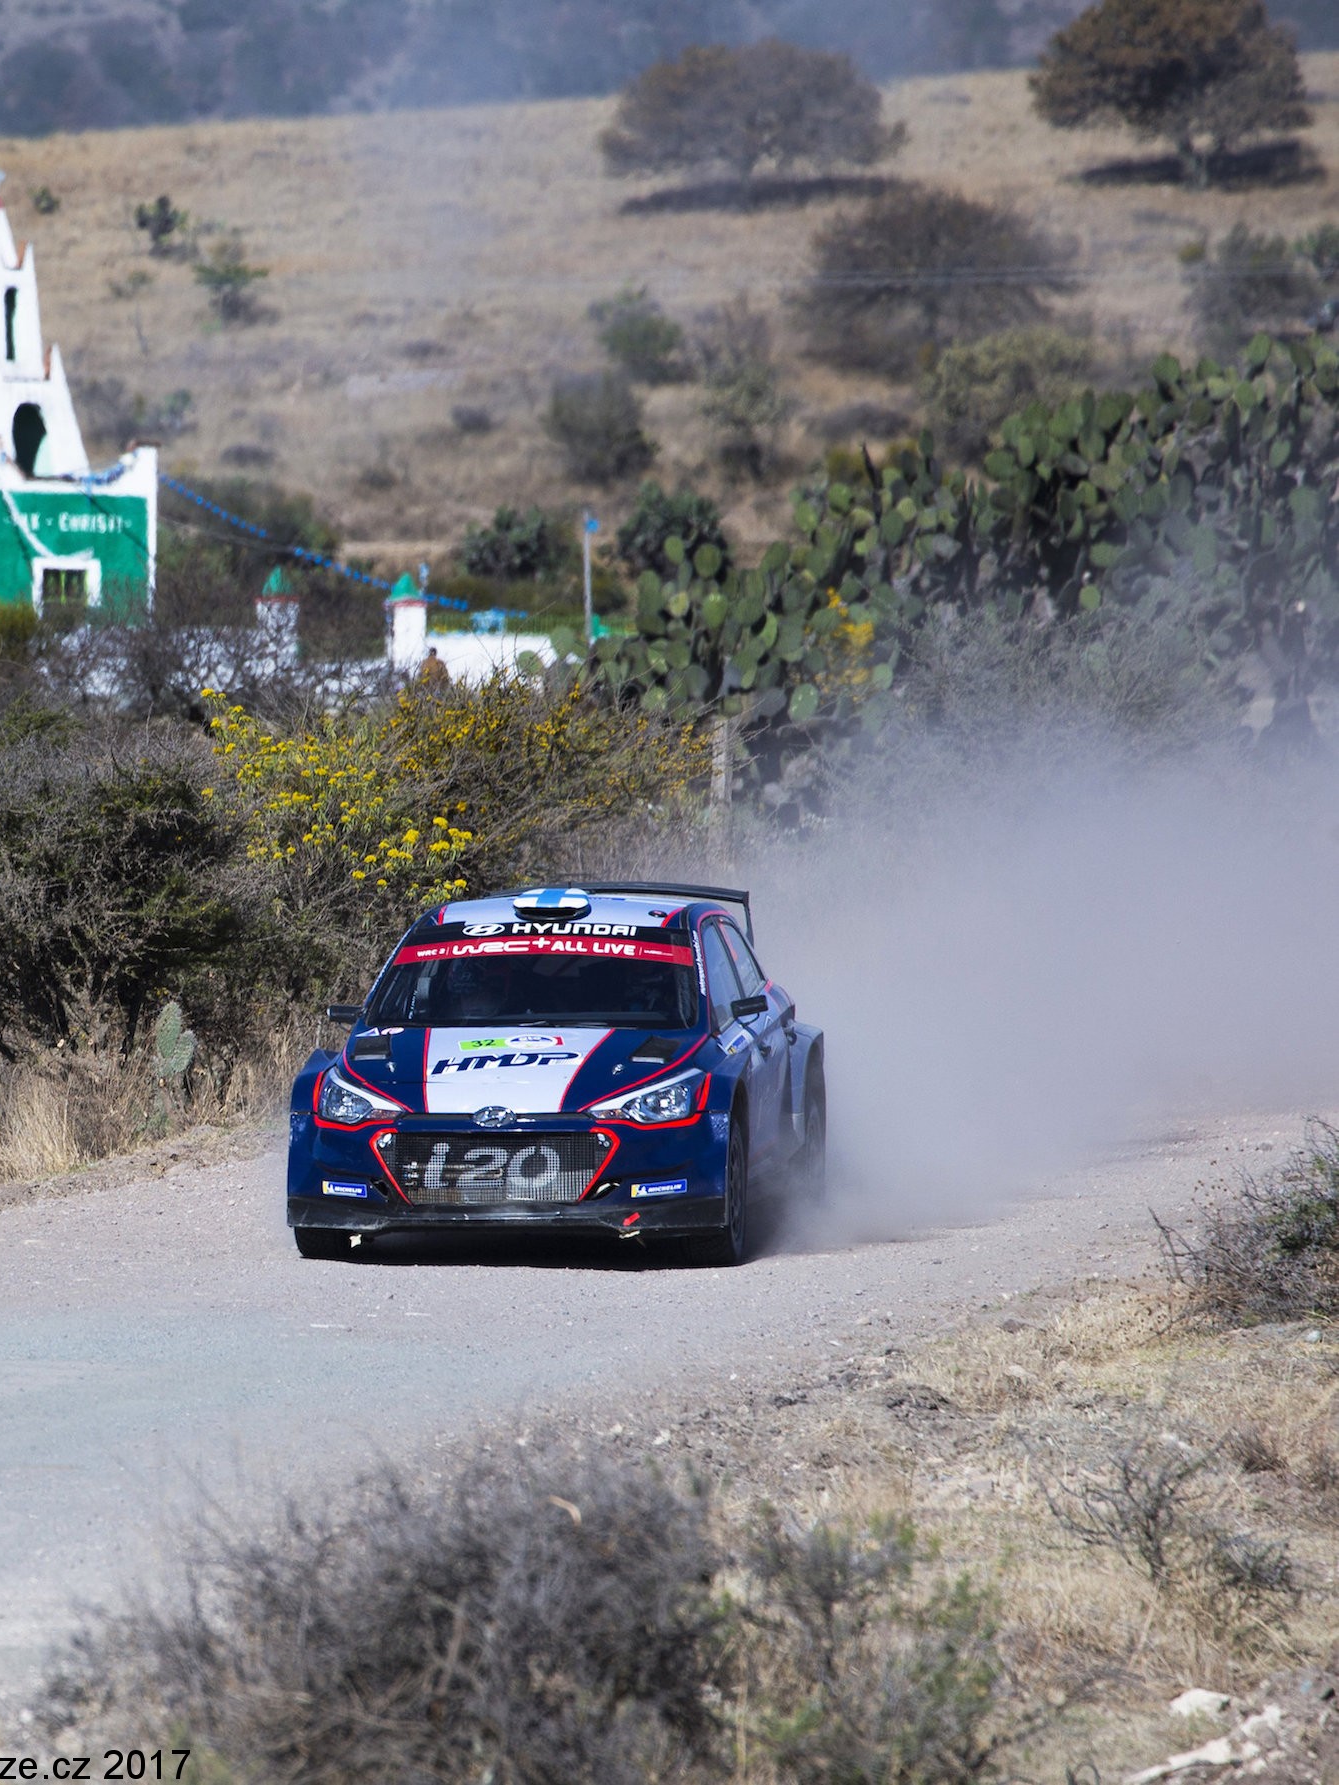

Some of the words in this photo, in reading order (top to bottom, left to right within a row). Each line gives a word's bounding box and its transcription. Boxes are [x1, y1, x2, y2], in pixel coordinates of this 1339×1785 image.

[511, 922, 637, 937] HYUNDAI
[551, 940, 588, 953] ALL
[592, 941, 636, 956] LIVE
[471, 1039, 497, 1048] 32
[430, 1052, 581, 1075] HMDP
[423, 1142, 560, 1189] i20
